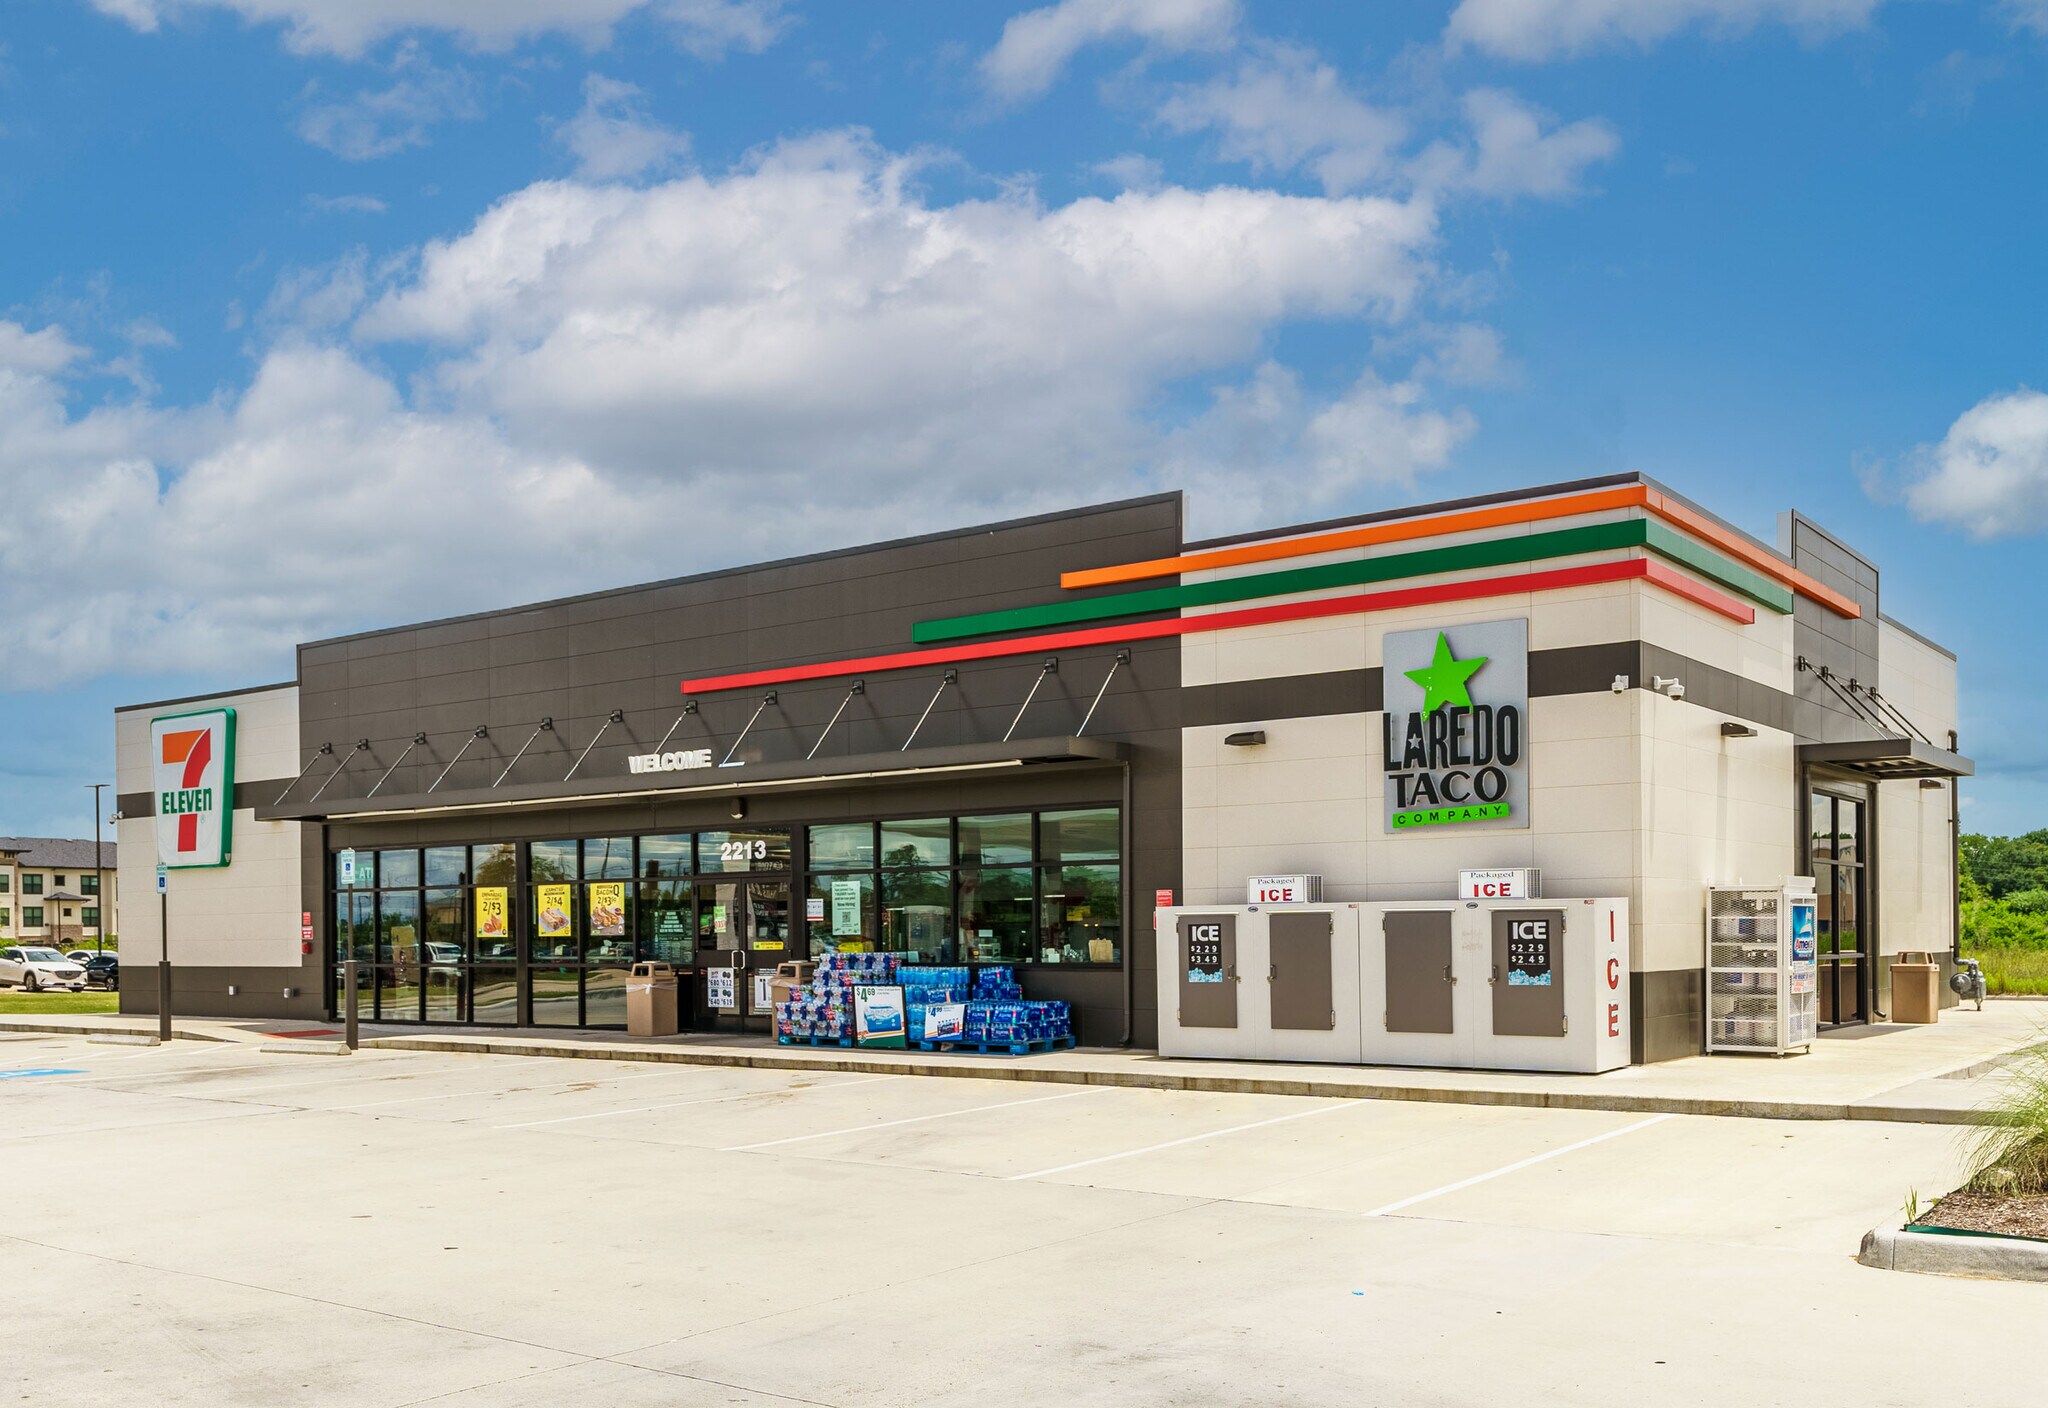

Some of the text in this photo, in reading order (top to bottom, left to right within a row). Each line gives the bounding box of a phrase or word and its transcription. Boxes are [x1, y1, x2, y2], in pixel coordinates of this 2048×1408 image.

[1383, 705, 1519, 771] LAREDO
[628, 749, 712, 774] WELCOME
[162, 728, 212, 852] 7
[1388, 766, 1508, 808] TACO
[1397, 806, 1503, 825] COMPANY
[721, 840, 767, 861] 2213
[1257, 877, 1296, 885] Packaged
[1470, 871, 1515, 879] Packaged
[1260, 888, 1293, 902] ICE
[1473, 883, 1512, 897] ICE
[483, 901, 501, 916] 2/$3
[546, 896, 563, 907] 2/$4
[1192, 926, 1219, 942] ICE
[1512, 922, 1547, 939] ICE
[1607, 907, 1619, 1037] ICE
